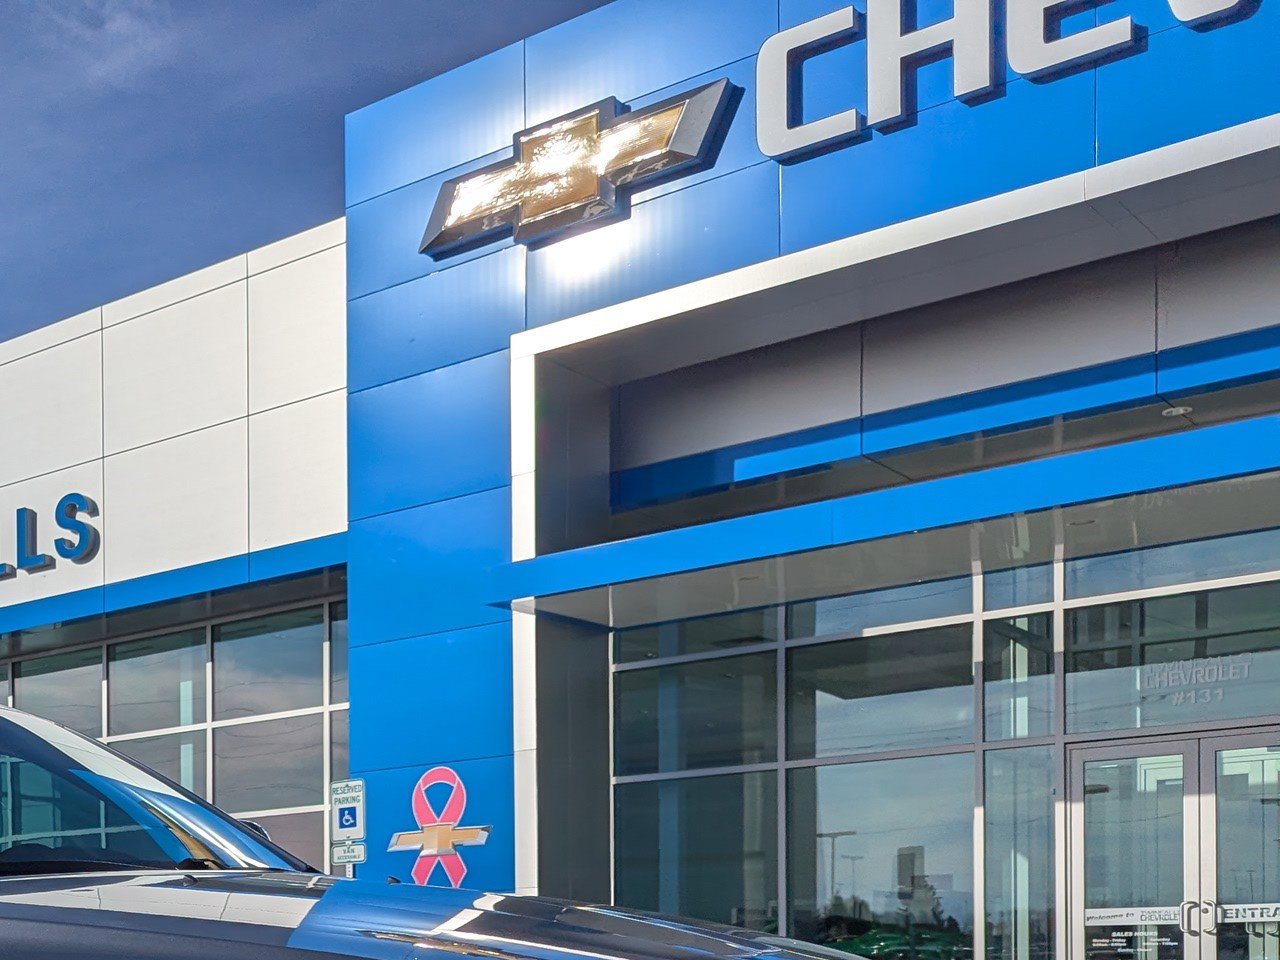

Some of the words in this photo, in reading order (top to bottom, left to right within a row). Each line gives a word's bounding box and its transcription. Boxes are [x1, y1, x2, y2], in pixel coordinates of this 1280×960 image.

[755, 0, 1258, 160] CHE
[332, 785, 362, 796] RESERVED
[334, 796, 361, 806] PARKING
[343, 846, 355, 855] VAN
